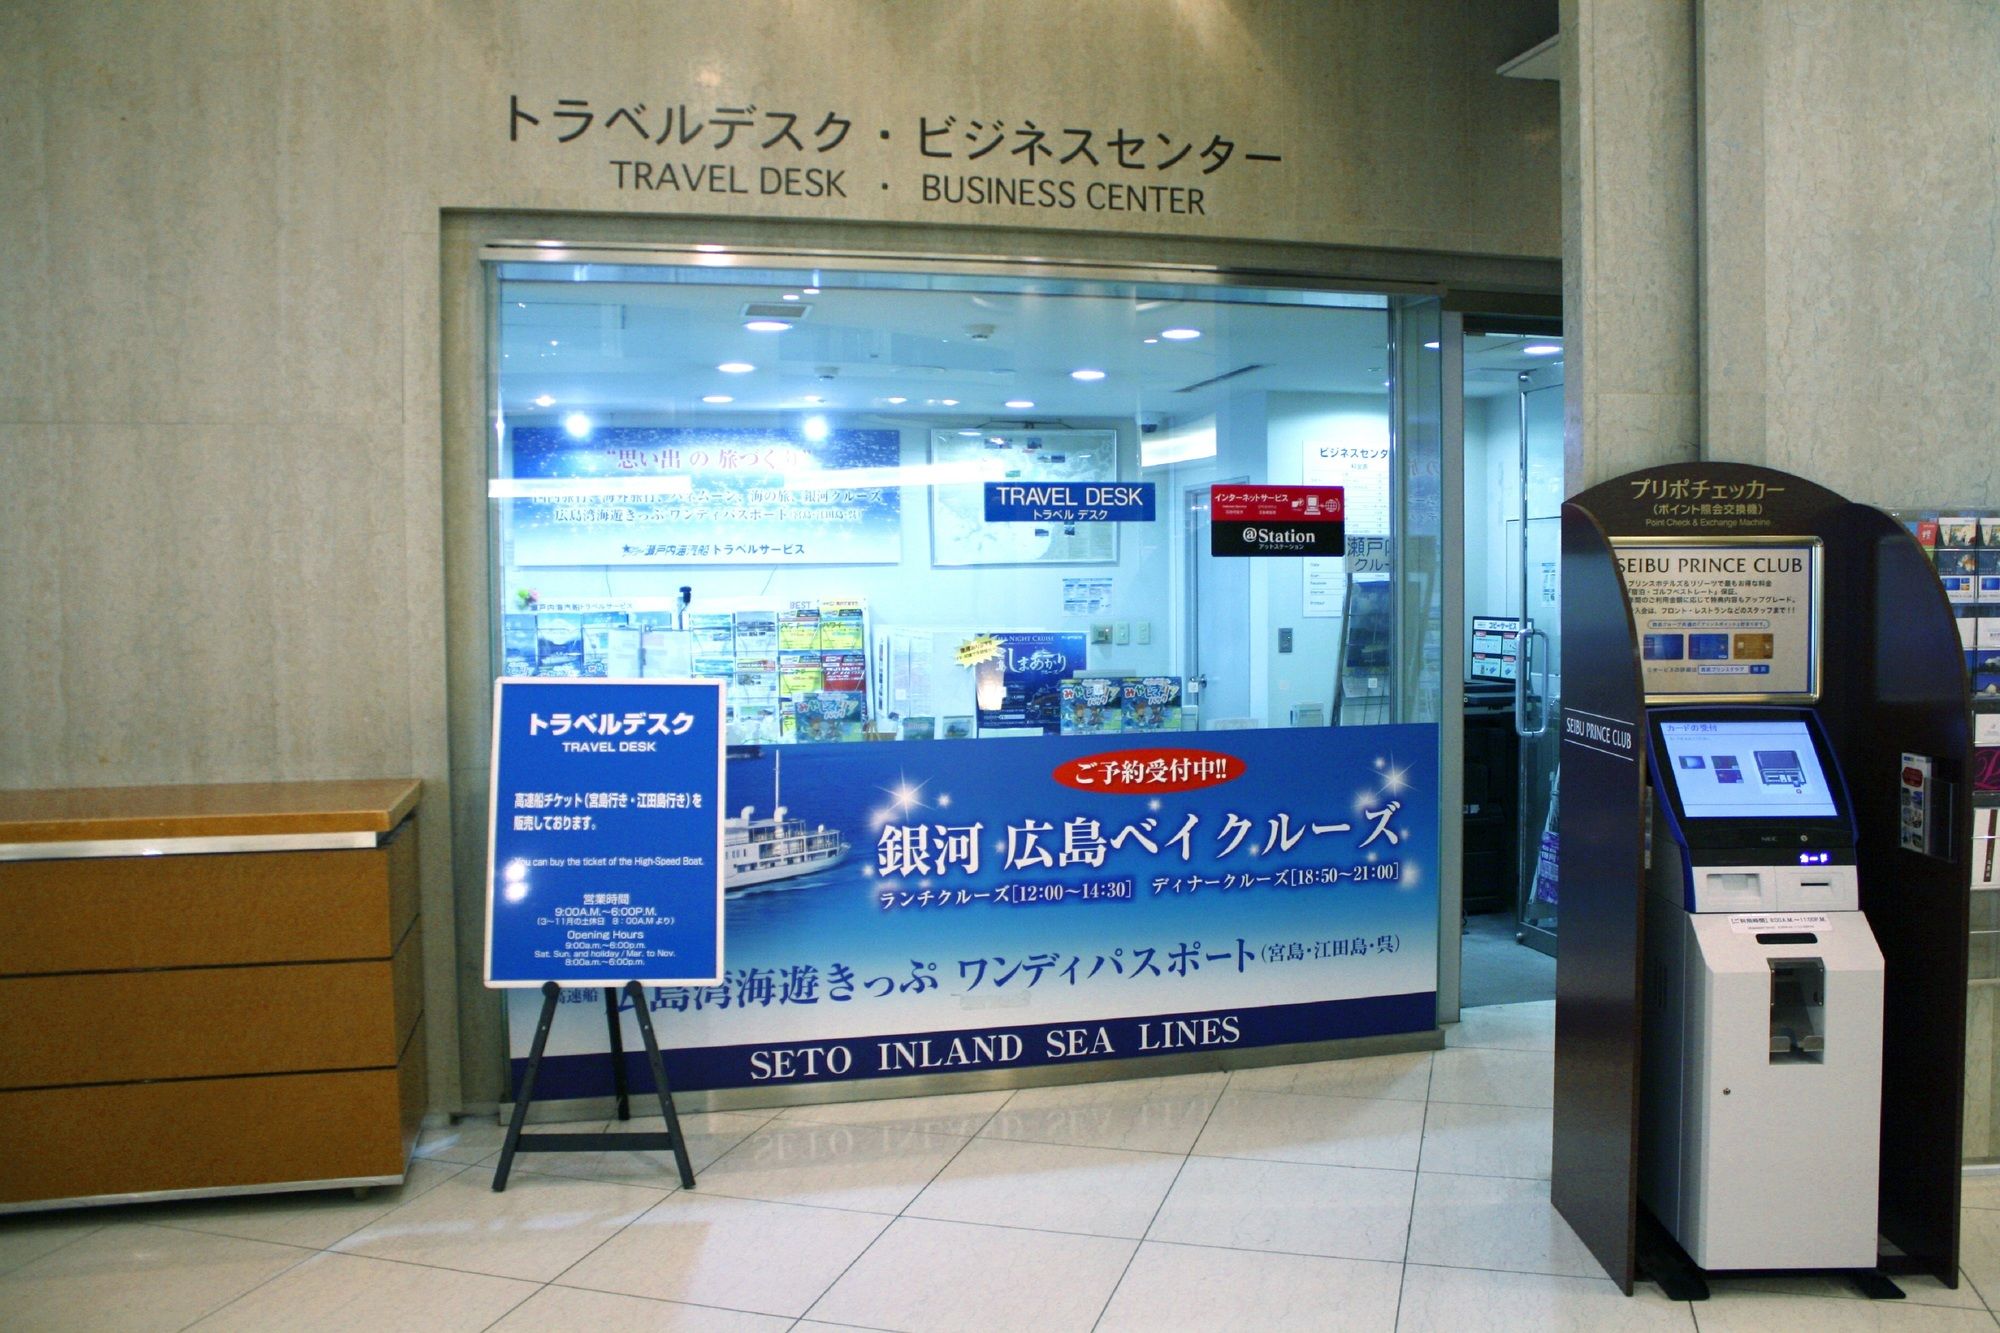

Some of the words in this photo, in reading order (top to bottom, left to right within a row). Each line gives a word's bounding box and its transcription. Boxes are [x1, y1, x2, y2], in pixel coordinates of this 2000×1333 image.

[510, 94, 1282, 175] トラベルデスク・ビジネスセンター
[609, 160, 748, 194] TRAVEL
[760, 167, 847, 198] DESK
[922, 174, 1076, 209] BUSINESS
[1086, 181, 1206, 215] CENTER
[996, 487, 1078, 506] TRAVEL
[1086, 487, 1144, 506] DESK
[1215, 493, 1289, 502] インターネットサービス
[1631, 479, 1785, 500] プリポチェッカー
[1646, 518, 1666, 526] Point
[1667, 518, 1691, 526] Check
[1700, 518, 1738, 528] Exchange
[1739, 518, 1772, 526] Machine
[1242, 527, 1316, 544] @Station
[1617, 558, 1670, 573] SEIBU
[1678, 558, 1746, 573] PRINCE
[1753, 558, 1803, 573] CLUB
[530, 712, 694, 736] トラベルデスク
[1566, 717, 1585, 737] SEIBU
[1586, 722, 1611, 744] PRINCE
[1612, 729, 1632, 749] CLUB
[562, 742, 616, 753] TRAVEL
[619, 742, 657, 753] DESK
[513, 815, 597, 831] 販売しております。
[876, 821, 984, 878] 銀河
[1002, 799, 1403, 872] 広島ベイクルーズ
[533, 858, 547, 867] can
[550, 857, 565, 869] buy
[567, 857, 581, 867] the
[583, 857, 606, 867] ticket
[609, 857, 617, 867] of
[619, 857, 633, 867] the
[634, 857, 681, 868] High-Speed
[682, 857, 704, 867] Boat.
[583, 893, 630, 906] 営業時間
[567, 930, 610, 941] Opening
[612, 930, 644, 939] Hours
[573, 950, 589, 958] and
[590, 950, 619, 960] holiday
[657, 950, 676, 958] Nov.
[750, 1045, 852, 1080] SETO
[877, 1034, 1024, 1071] INLAND
[1046, 1024, 1116, 1058] SEA
[1138, 1015, 1241, 1052] LINES
